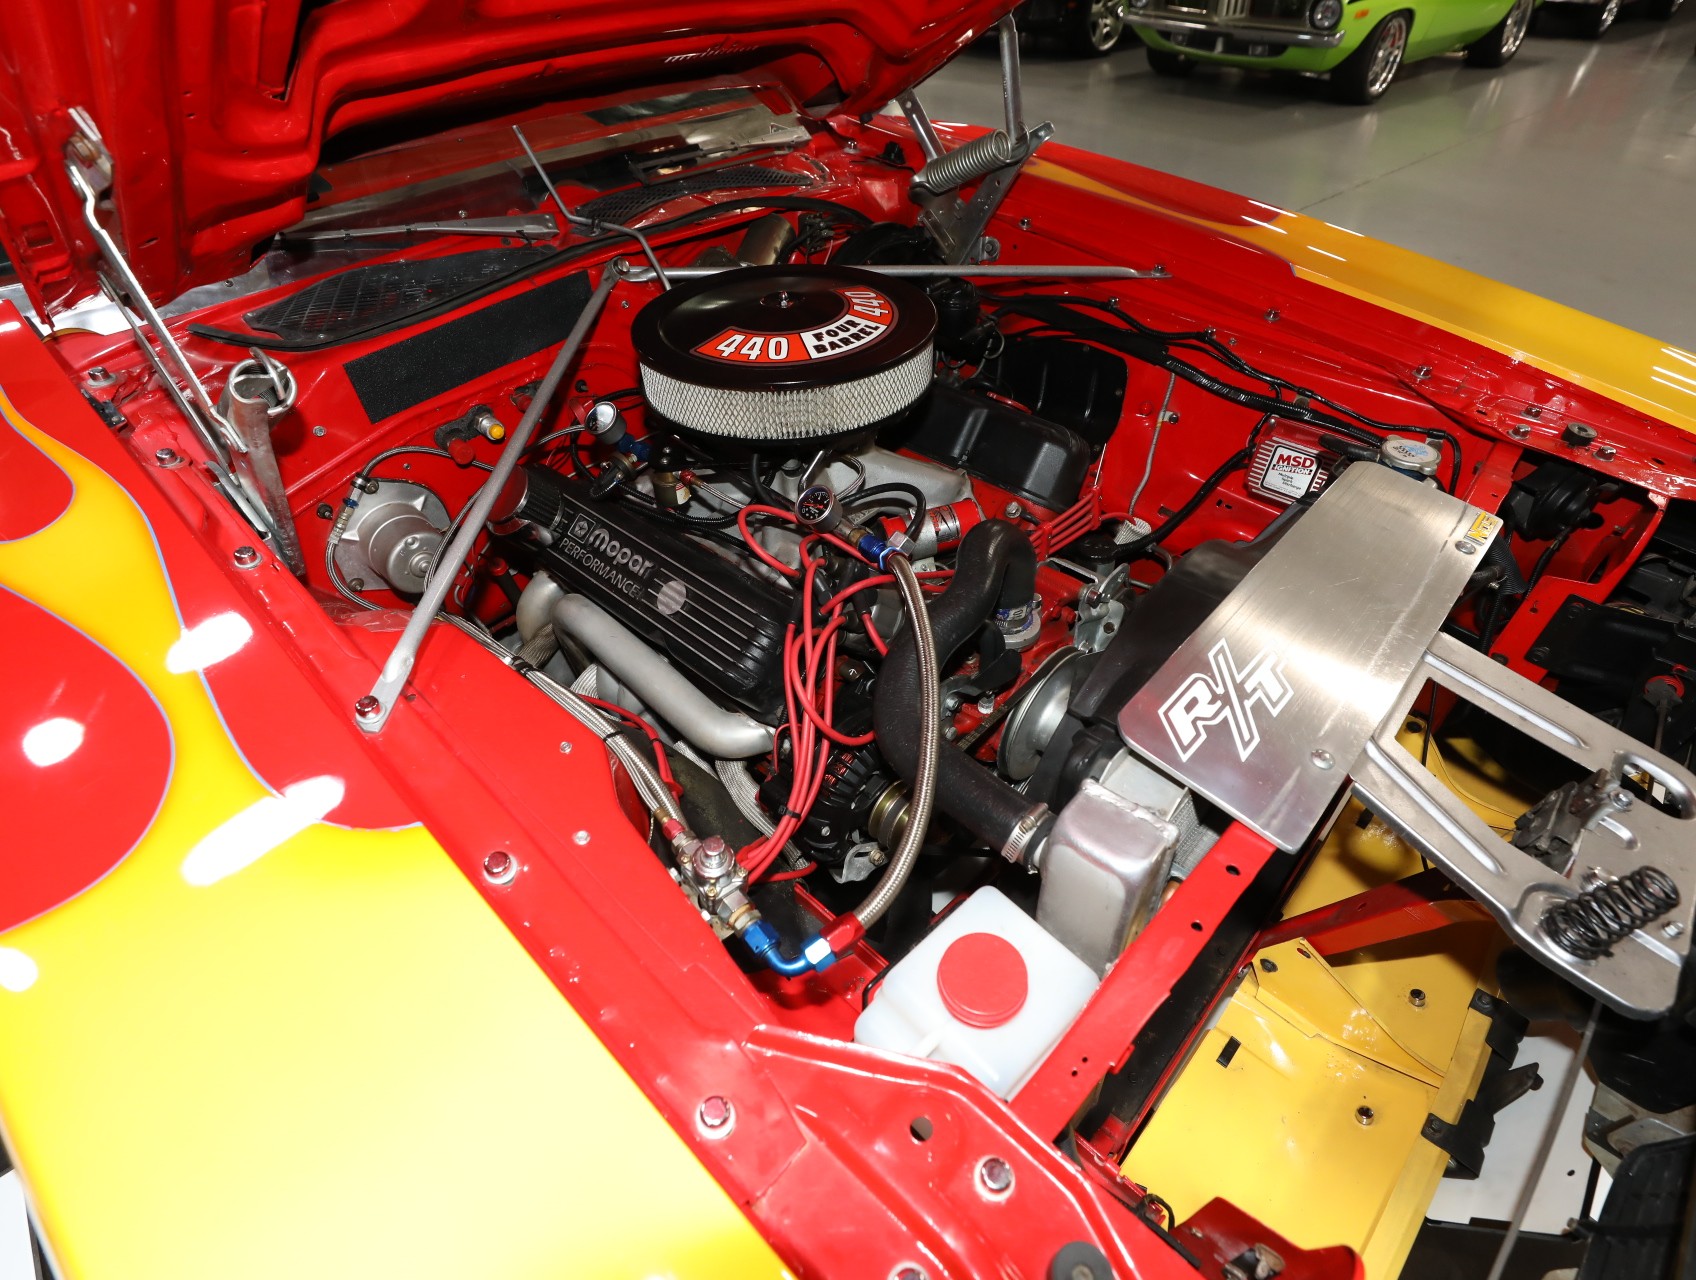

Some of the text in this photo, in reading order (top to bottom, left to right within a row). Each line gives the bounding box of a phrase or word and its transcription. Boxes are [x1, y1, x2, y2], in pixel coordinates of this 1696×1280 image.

[843, 290, 889, 318] 440
[812, 319, 863, 343] FOUR
[814, 324, 880, 354] BARREL
[717, 334, 789, 360] 440
[1274, 464, 1310, 475] IGNITION
[1276, 453, 1315, 469] MSD
[559, 538, 640, 598] PERFORMANCE
[1157, 637, 1295, 763] R/T
